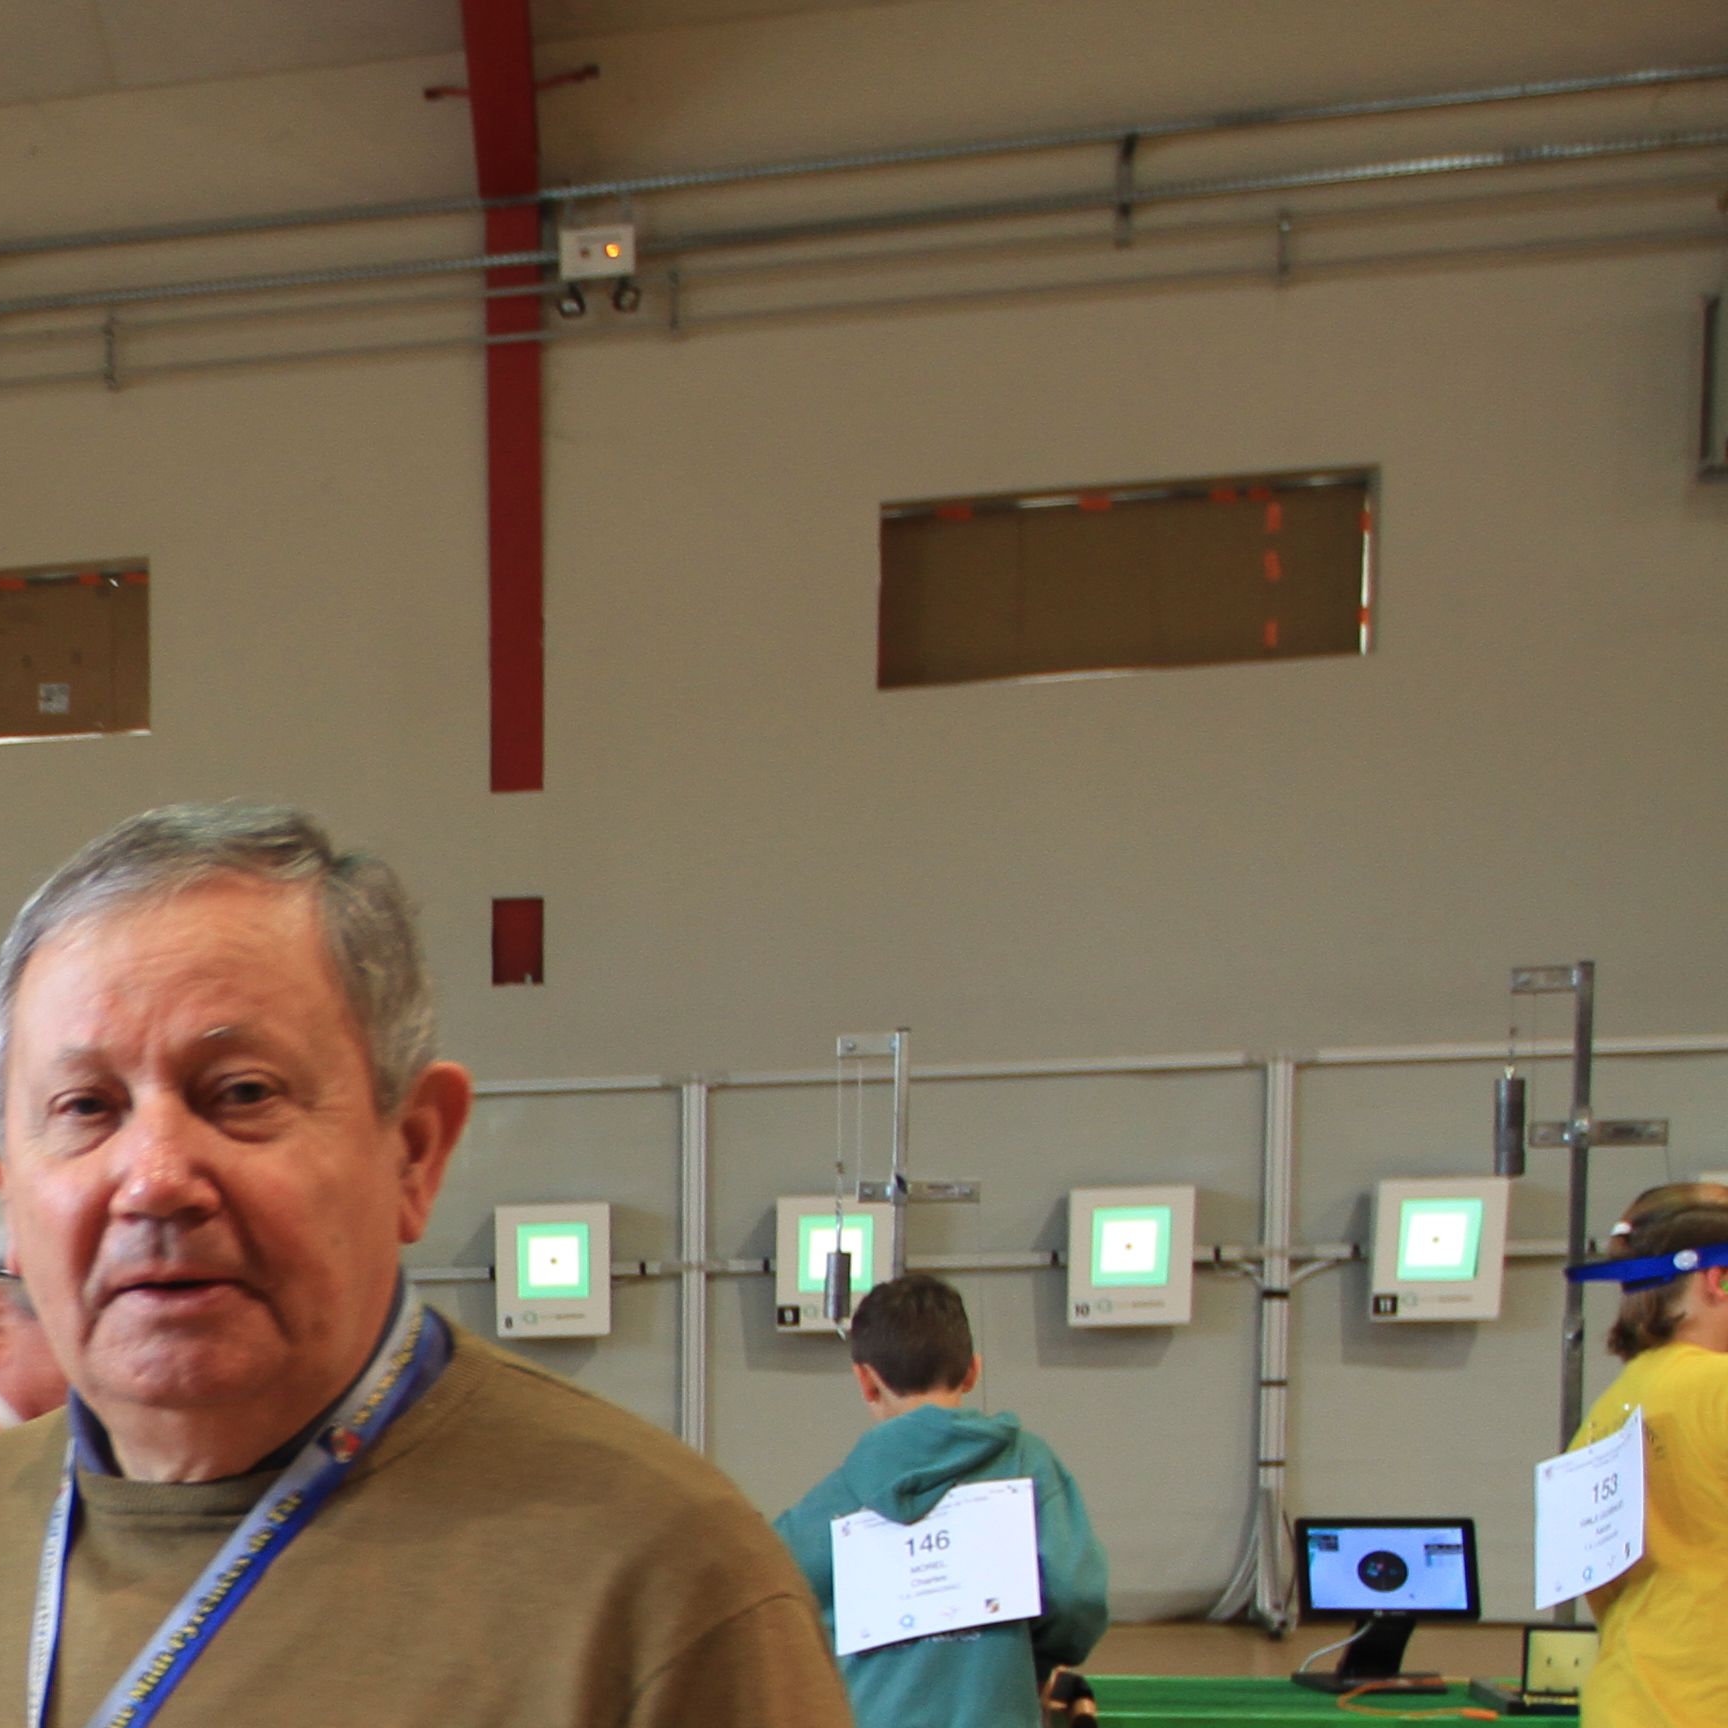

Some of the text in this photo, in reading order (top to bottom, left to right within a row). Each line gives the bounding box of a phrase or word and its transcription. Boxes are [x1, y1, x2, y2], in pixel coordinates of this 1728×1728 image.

[1075, 1303, 1090, 1317] 10
[1593, 1473, 1619, 1504] 153
[248, 1529, 273, 1555] de
[905, 1529, 951, 1557] 146
